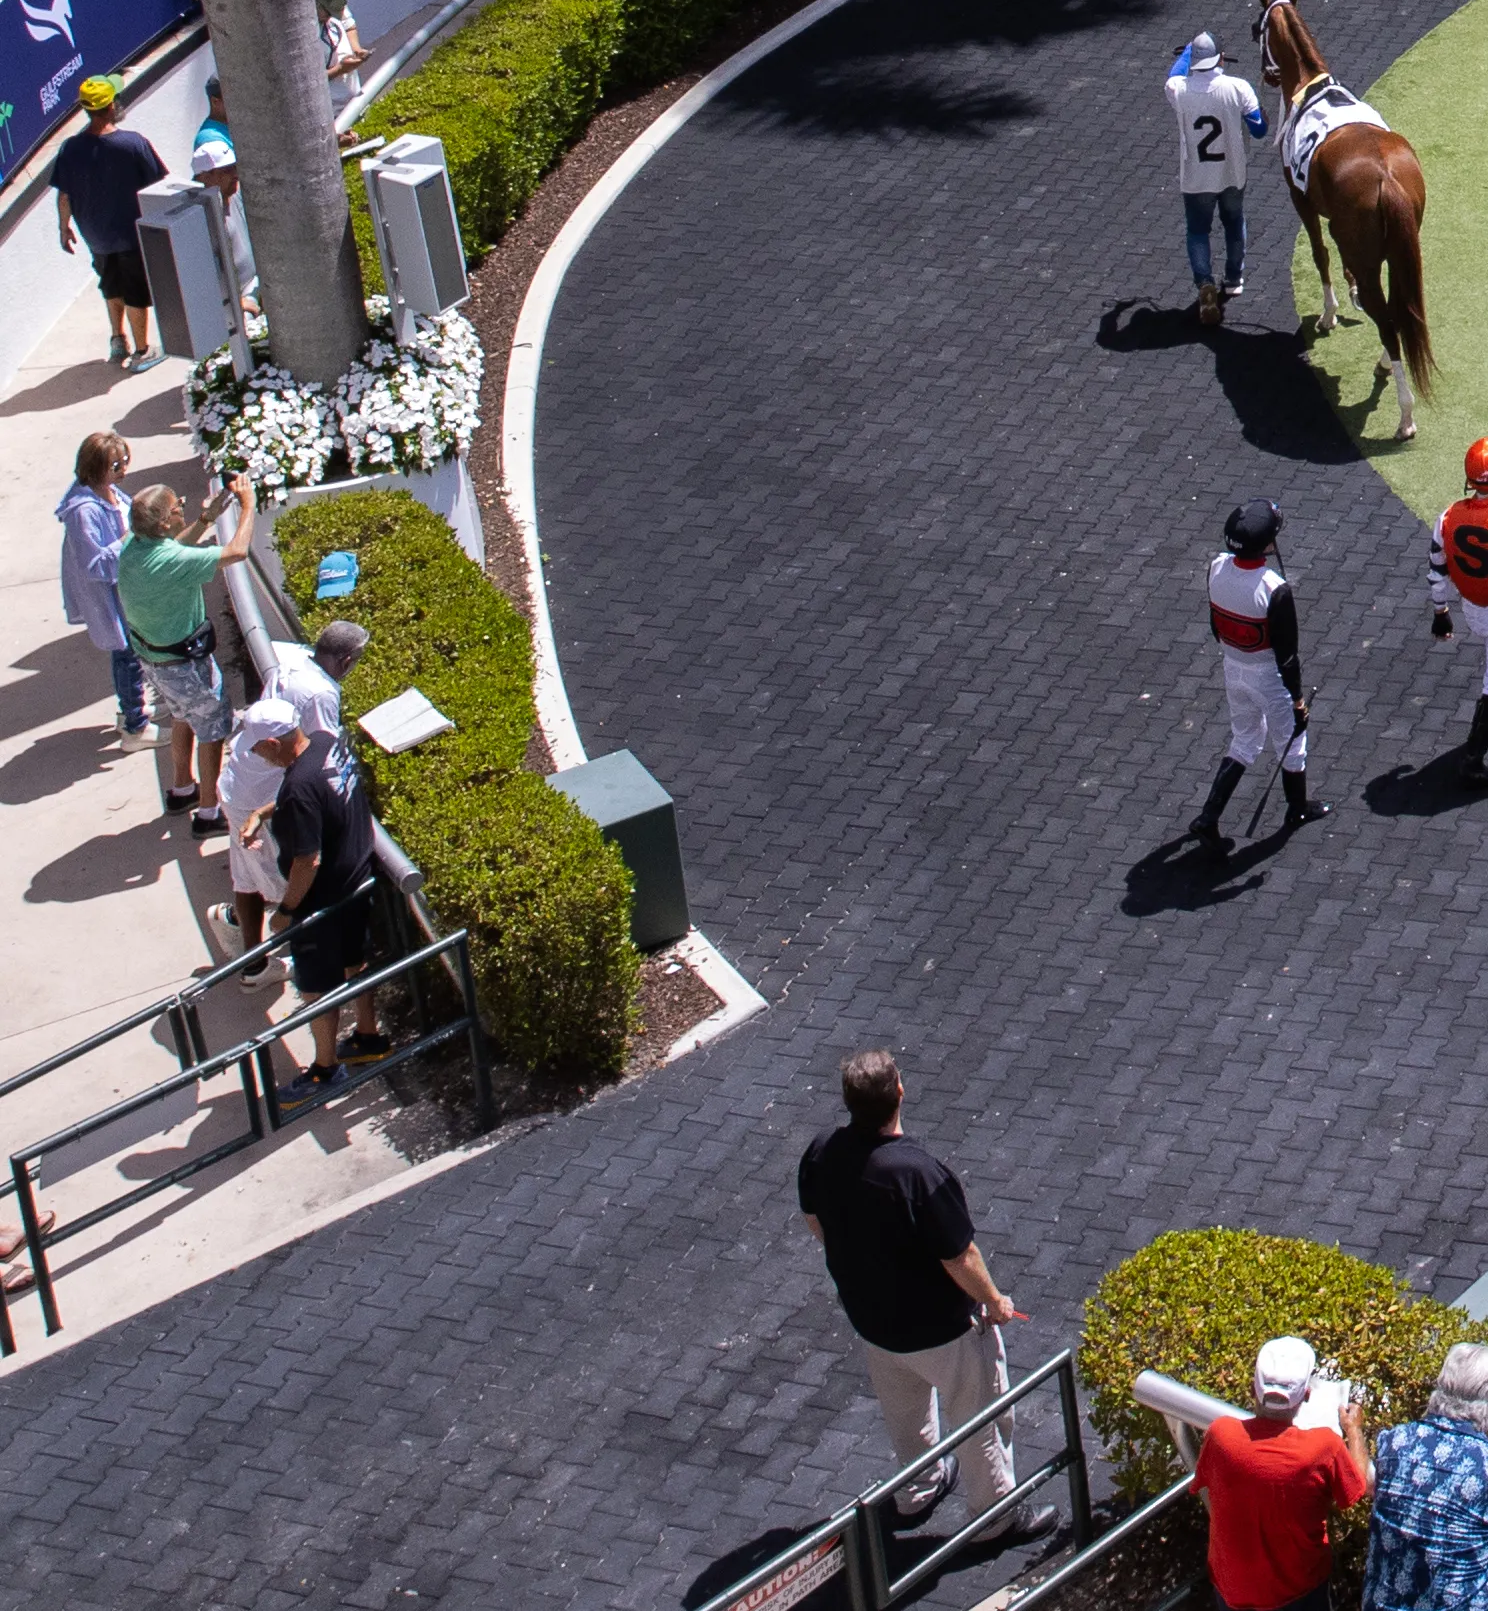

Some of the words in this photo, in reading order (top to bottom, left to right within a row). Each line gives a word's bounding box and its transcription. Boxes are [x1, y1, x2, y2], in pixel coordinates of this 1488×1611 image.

[1193, 115, 1225, 163] 2
[798, 1557, 831, 1585] INJURY
[792, 1579, 817, 1601] PATH
